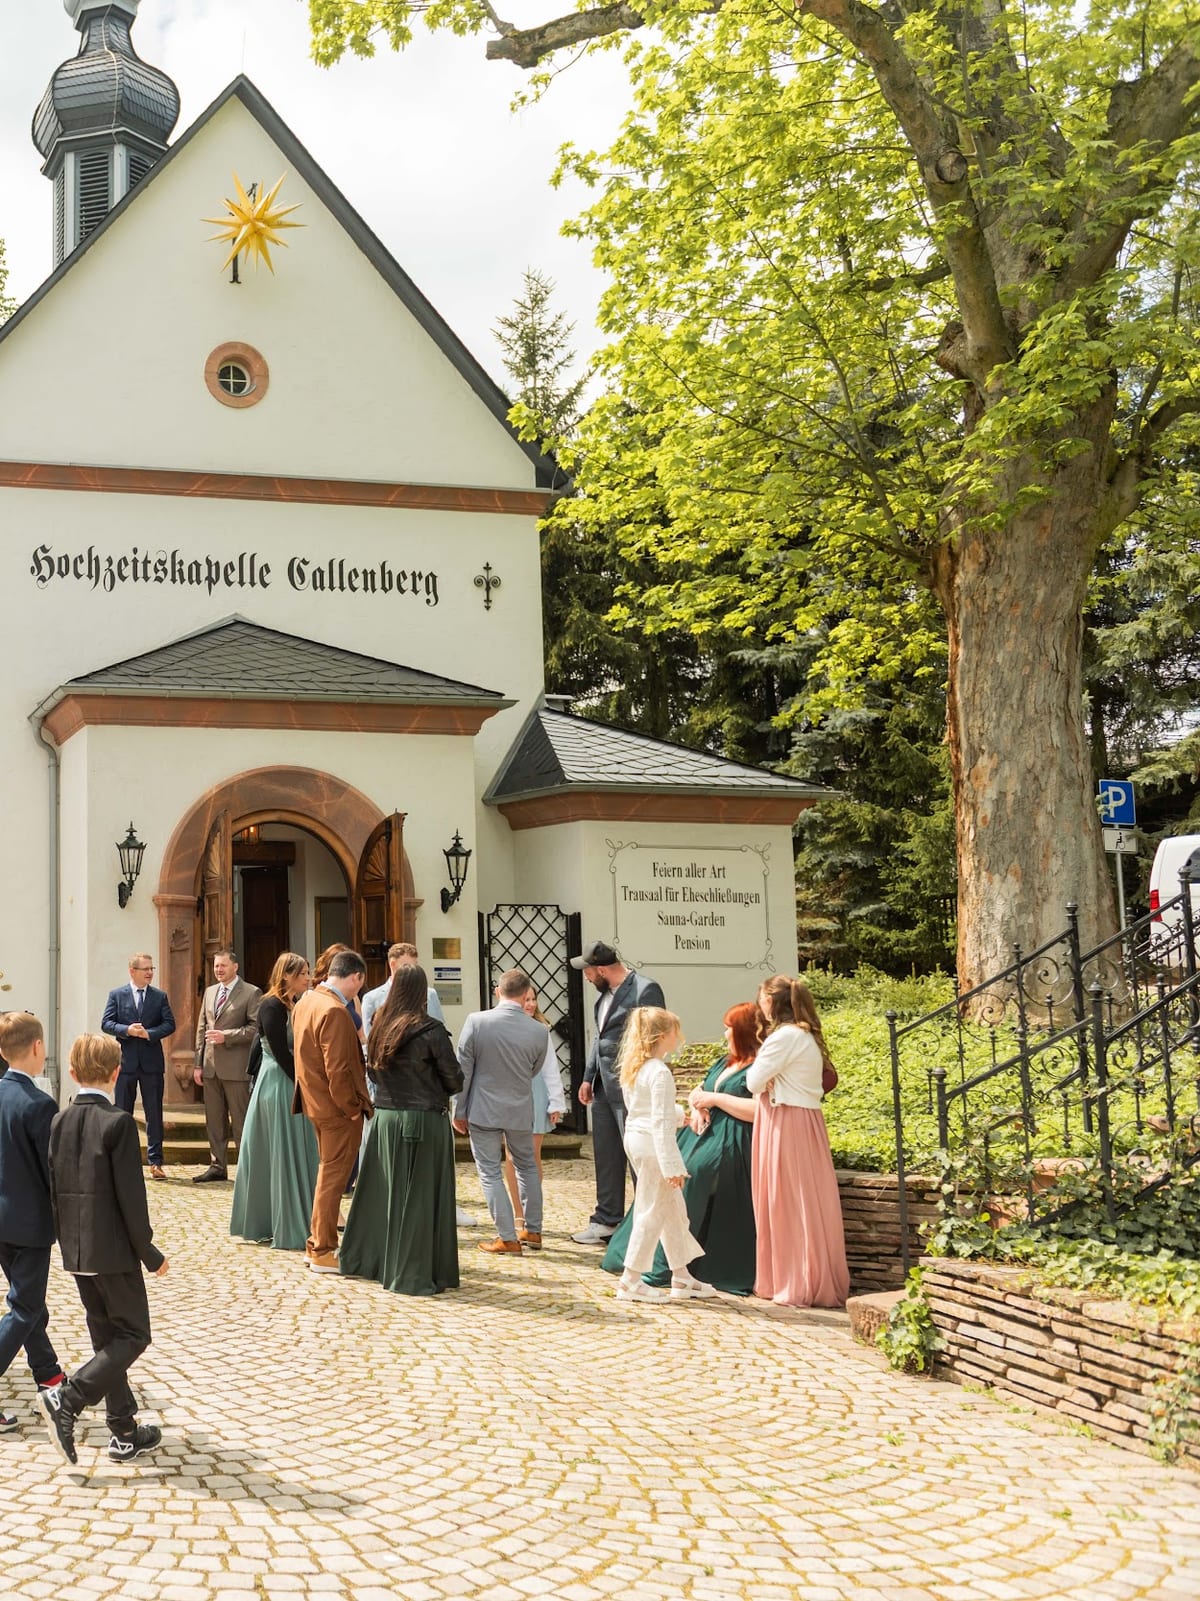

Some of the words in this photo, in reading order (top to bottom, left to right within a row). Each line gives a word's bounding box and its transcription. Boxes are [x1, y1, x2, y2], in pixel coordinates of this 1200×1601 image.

[29, 543, 272, 597] Hochzeitskapelle
[287, 556, 440, 608] Callenberg
[1108, 786, 1126, 818] P
[652, 861, 683, 878] Feiern
[684, 862, 707, 878] aller
[709, 864, 726, 879] Art
[621, 885, 663, 902] Trausaal
[664, 886, 680, 903] für
[681, 886, 761, 908] Eheschließungen
[657, 910, 726, 927] Sauna-Garden
[674, 934, 711, 950] Pension
